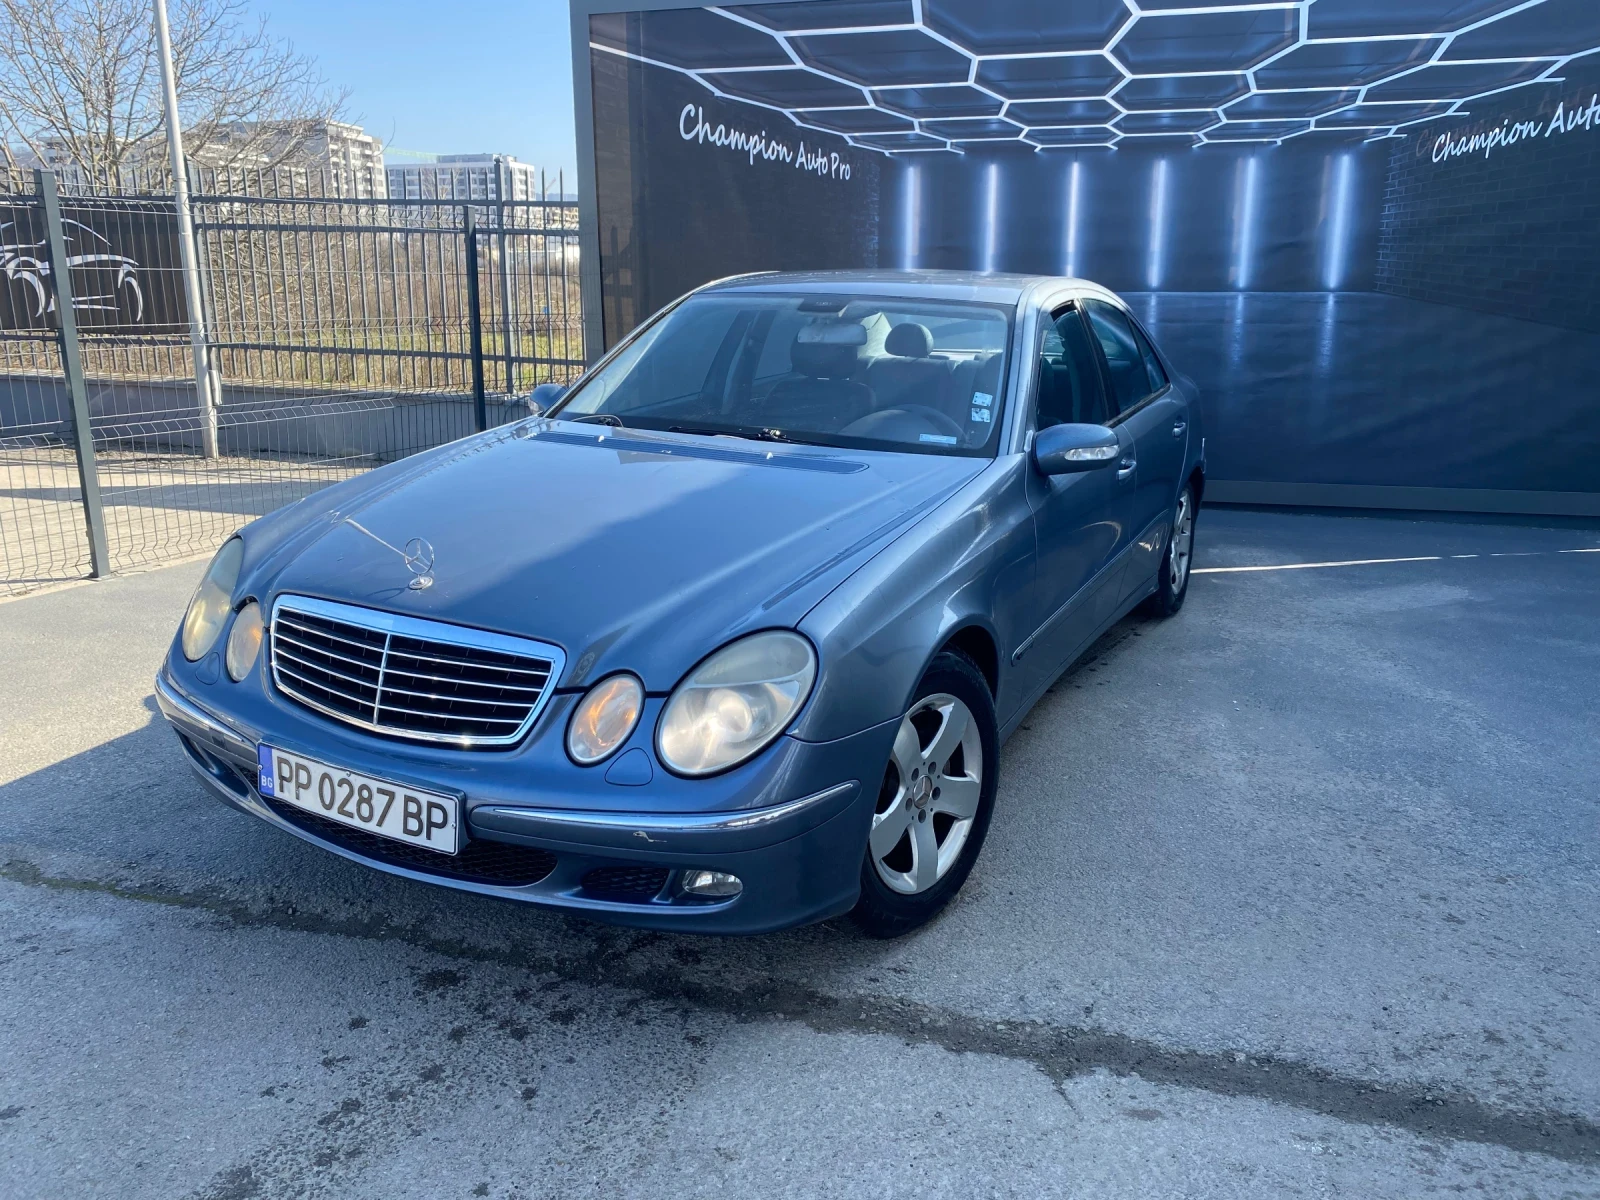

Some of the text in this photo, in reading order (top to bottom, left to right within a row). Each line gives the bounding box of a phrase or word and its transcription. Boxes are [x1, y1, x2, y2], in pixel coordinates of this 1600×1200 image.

[679, 103, 851, 180] Champion Auto Pro
[1431, 118, 1543, 163] Champion
[261, 775, 273, 788] BG
[277, 756, 448, 840] PP 0287 BP
